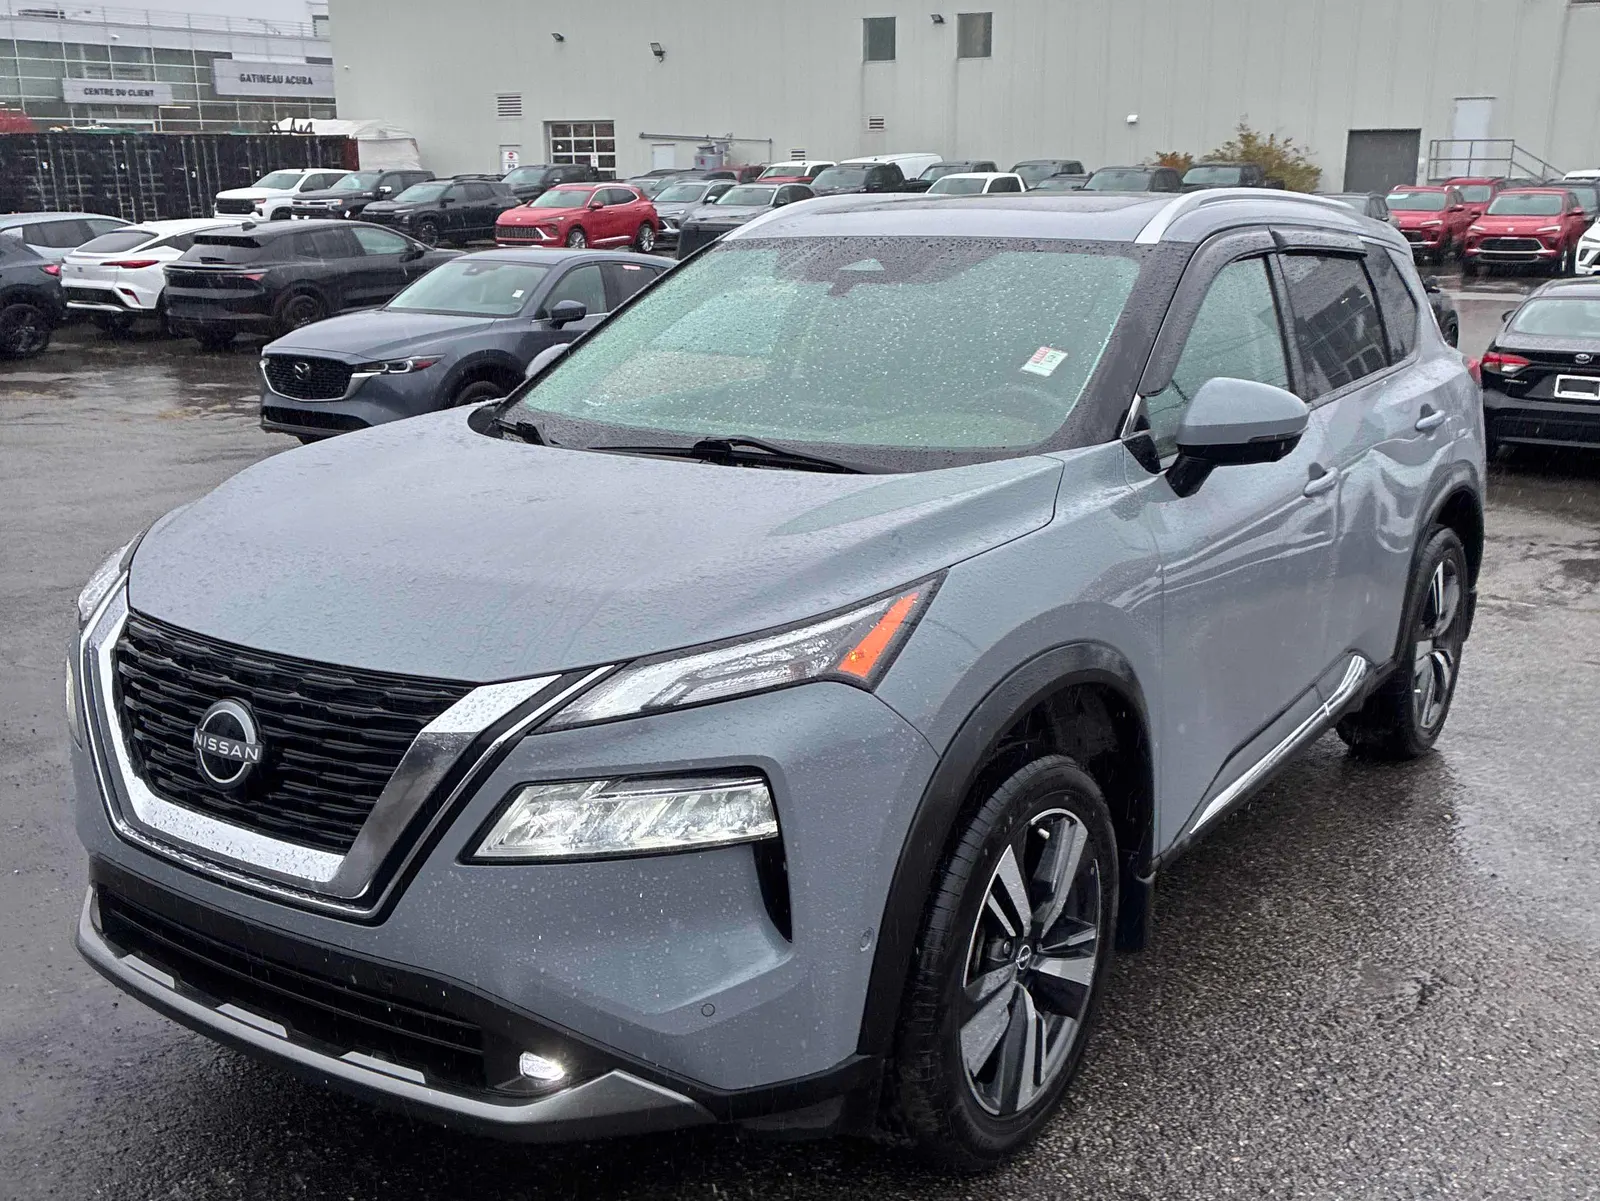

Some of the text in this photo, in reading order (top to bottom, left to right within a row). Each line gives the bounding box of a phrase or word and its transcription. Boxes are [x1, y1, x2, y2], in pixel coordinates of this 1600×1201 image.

[240, 73, 314, 85] GATINEAU ACURA
[84, 87, 154, 97] CENTRE DU CLIENT
[193, 730, 259, 761] NISSAN
